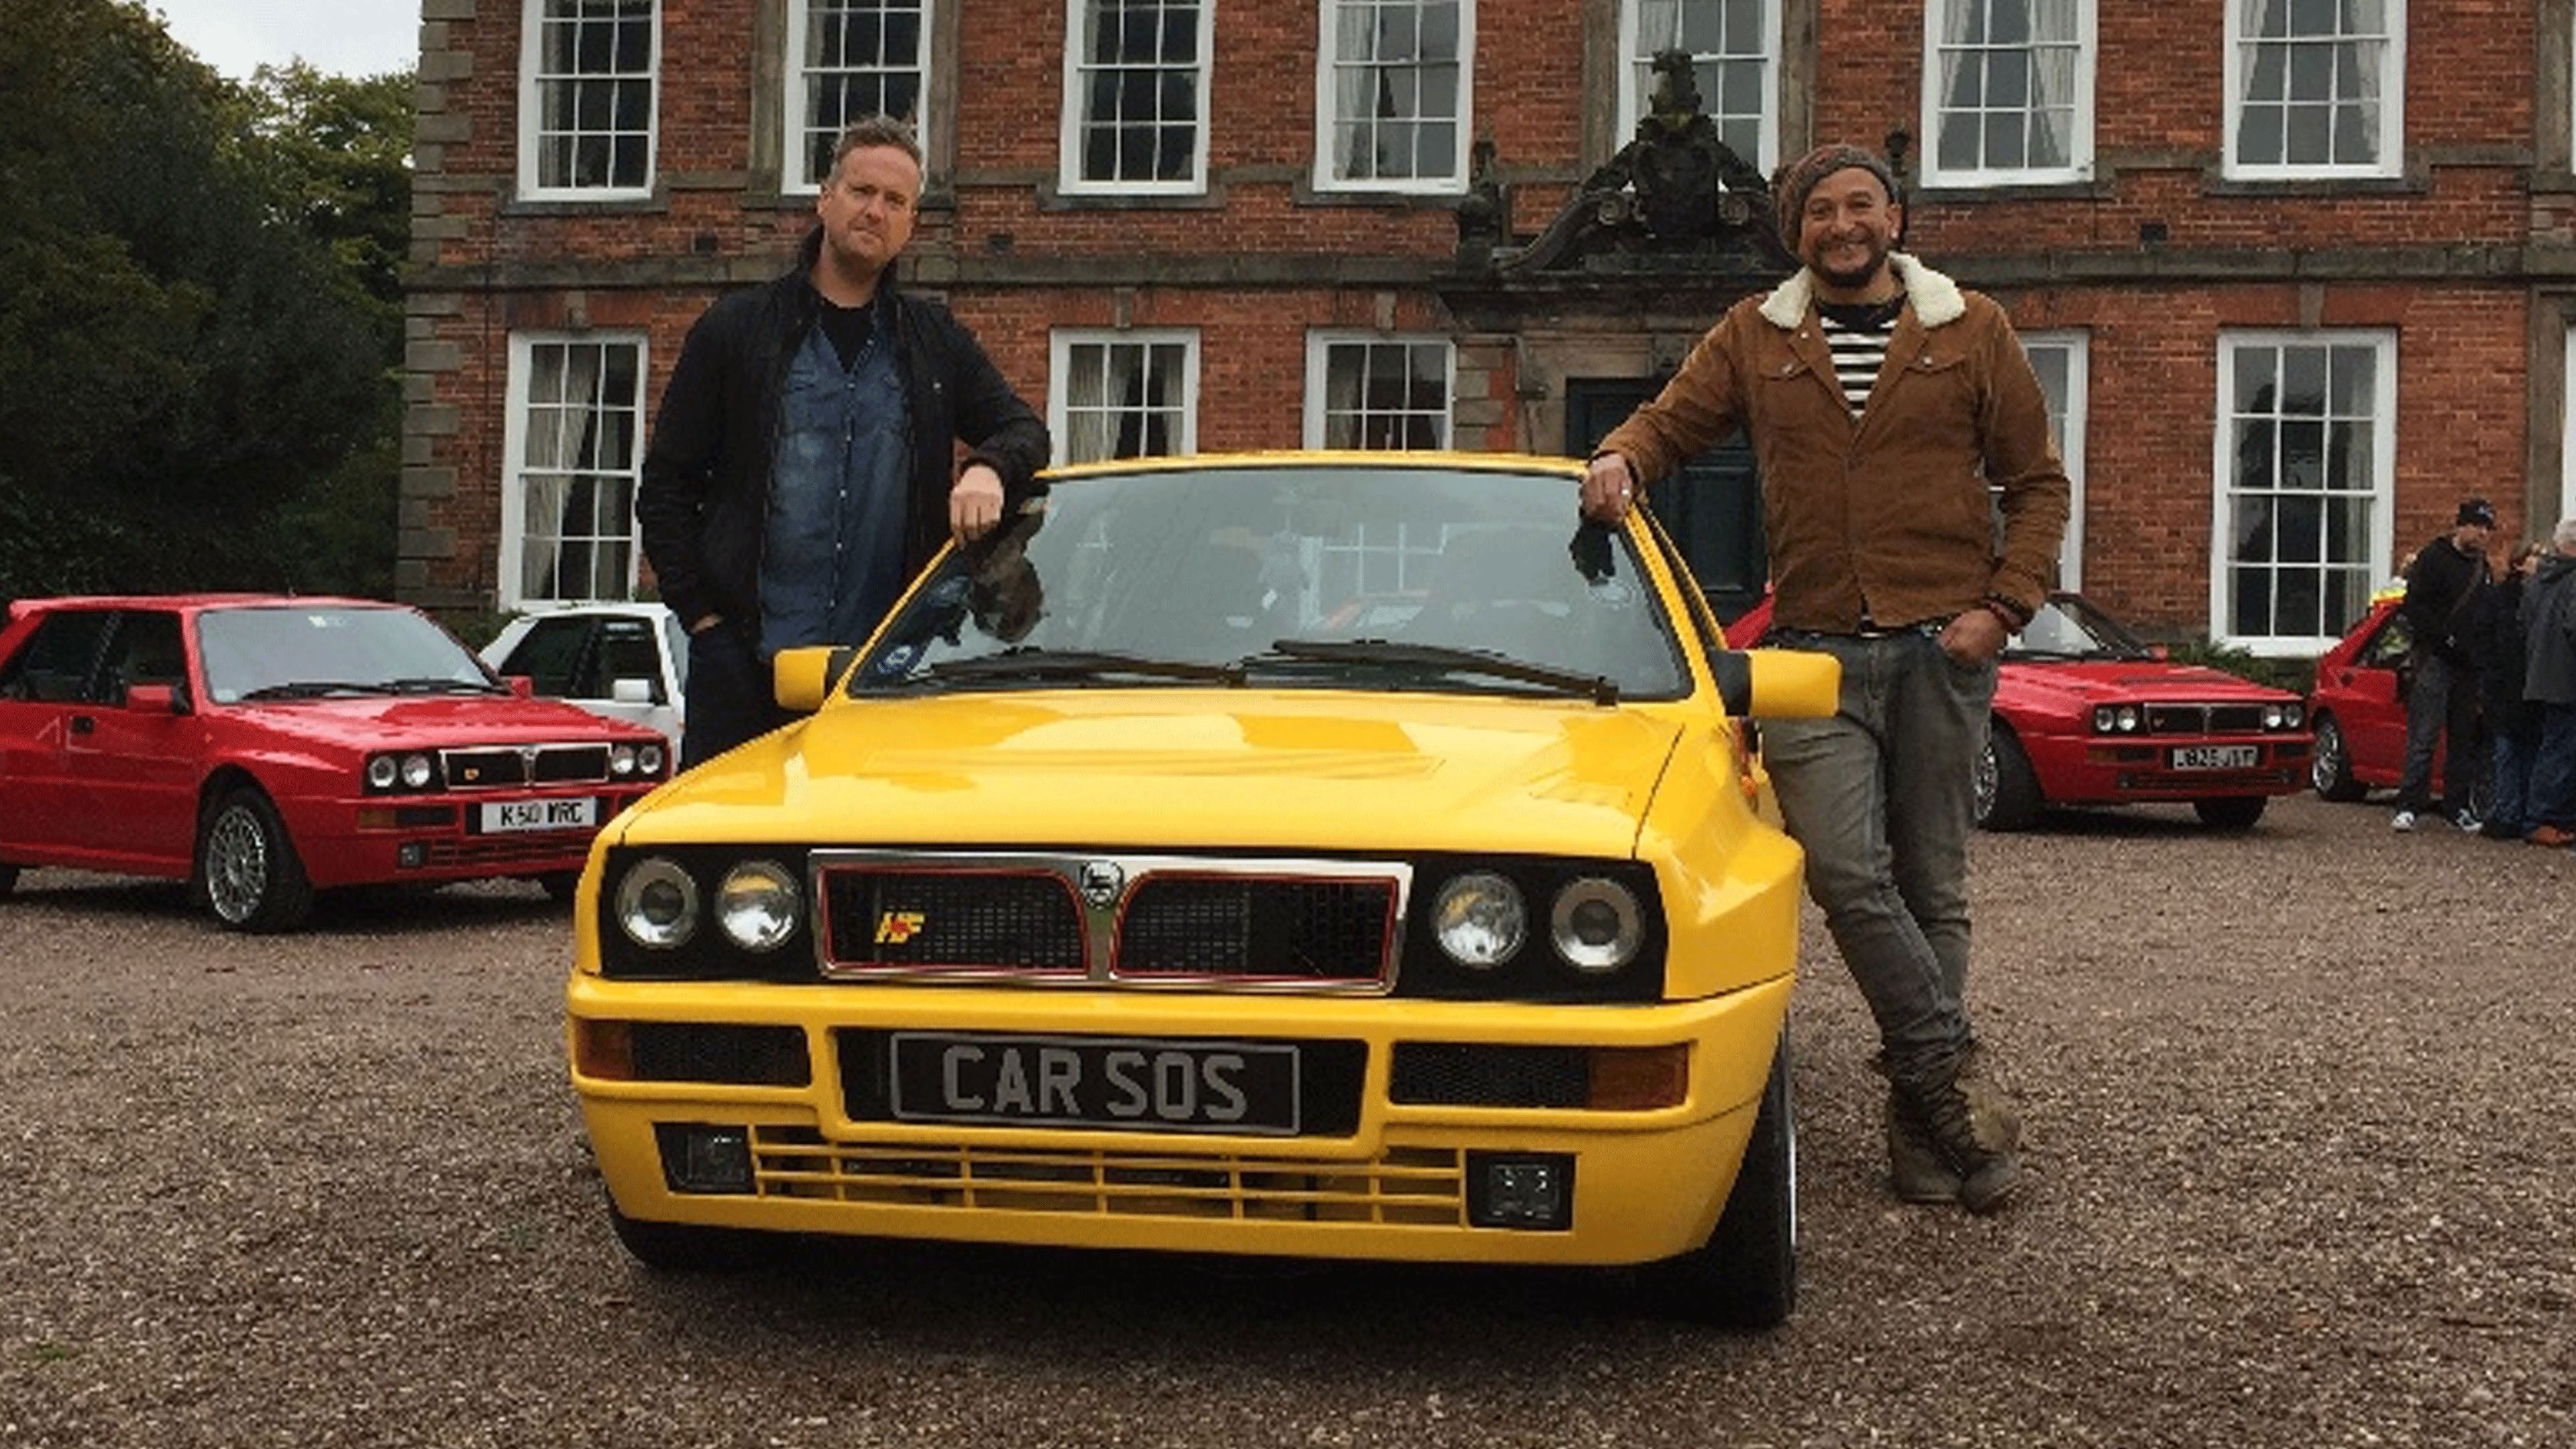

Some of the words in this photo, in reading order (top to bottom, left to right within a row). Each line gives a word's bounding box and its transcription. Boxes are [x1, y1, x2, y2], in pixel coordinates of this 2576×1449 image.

[873, 912, 925, 944] HF
[943, 1044, 1082, 1116] CAR
[1105, 1050, 1248, 1122] SOS
